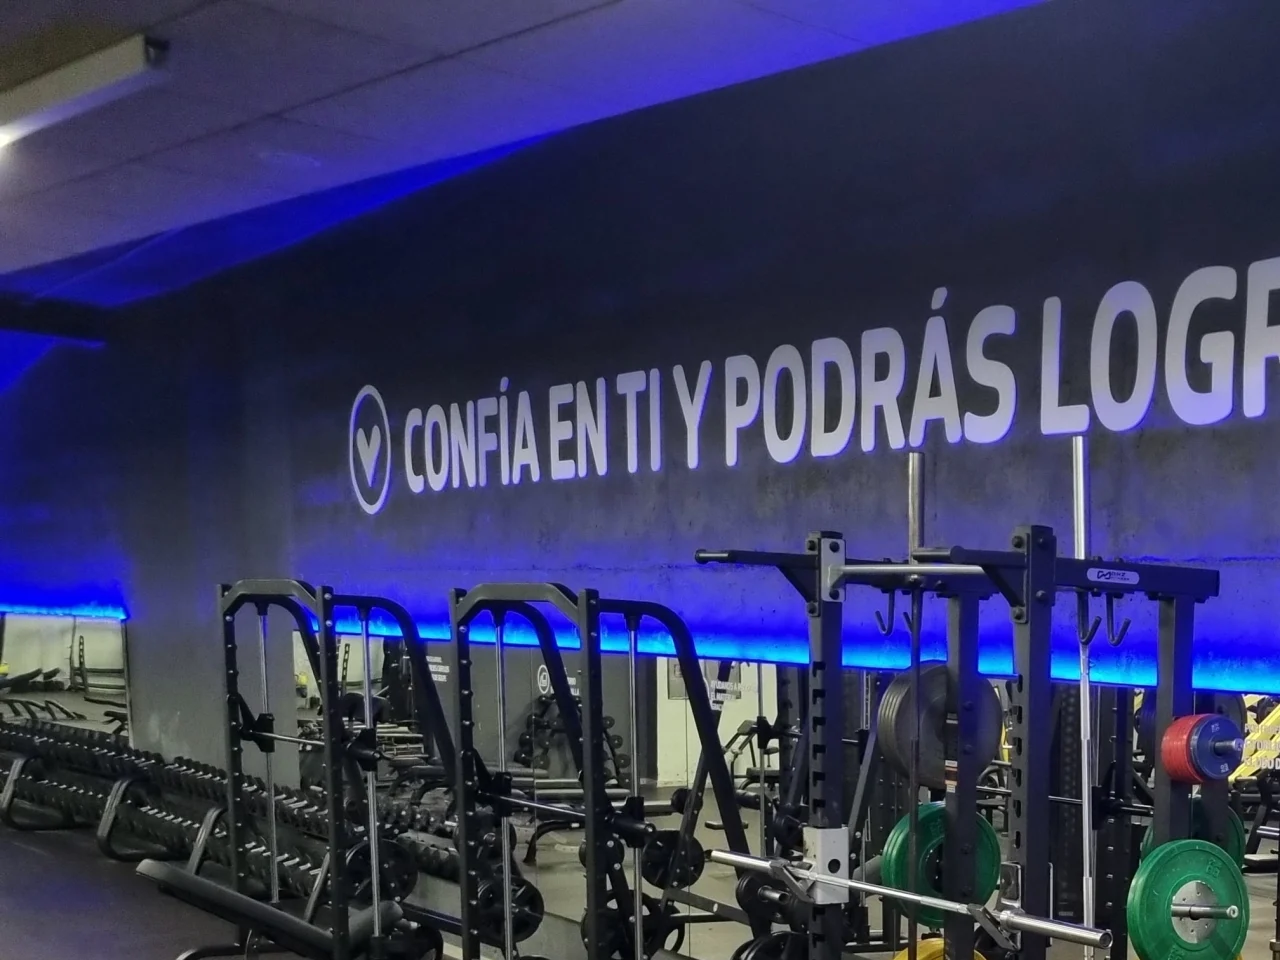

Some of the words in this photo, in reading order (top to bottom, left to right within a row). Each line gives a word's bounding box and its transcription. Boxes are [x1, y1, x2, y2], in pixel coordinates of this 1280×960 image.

[404, 377, 541, 494] CONFÍA
[549, 377, 608, 481] EN
[616, 368, 662, 474] TI
[673, 360, 713, 469] Y
[725, 287, 1017, 468] PODRÁS
